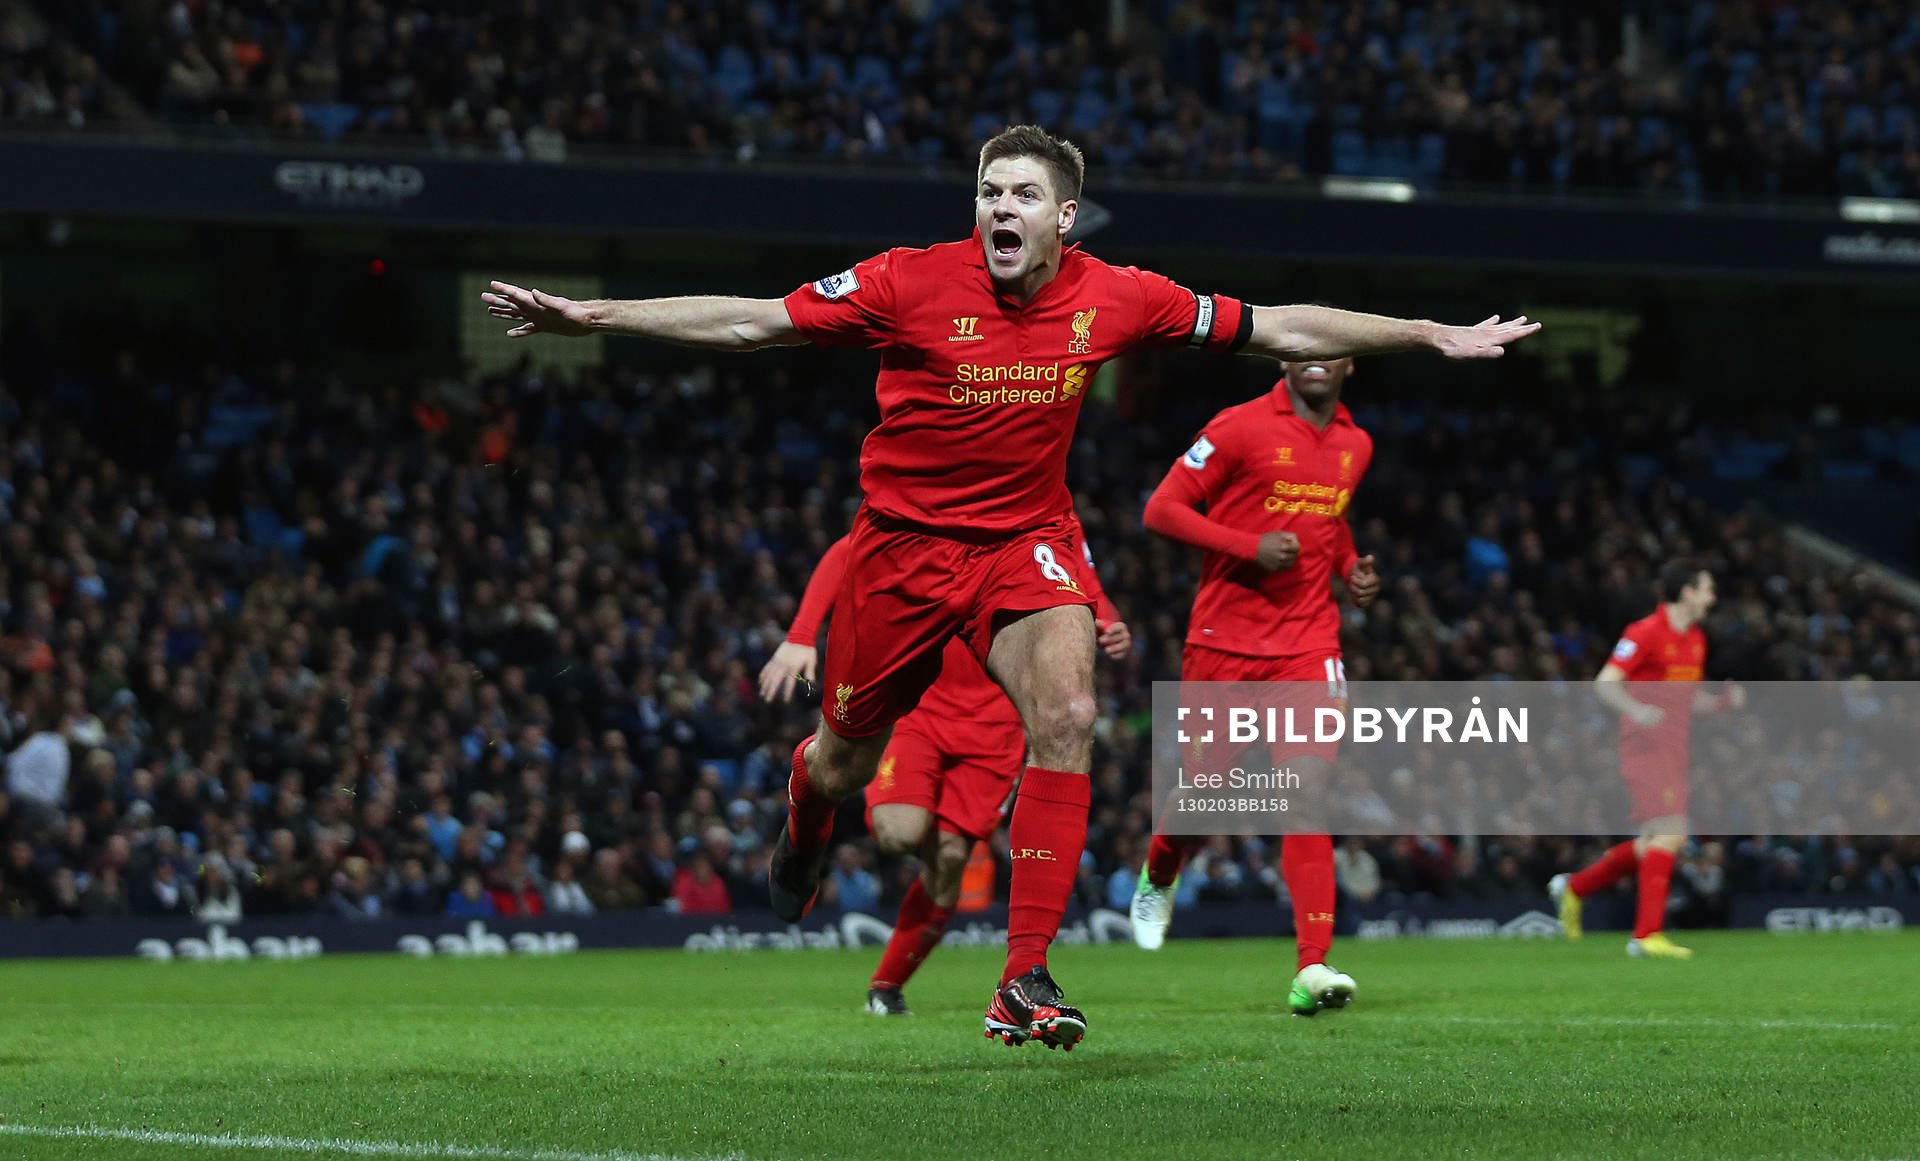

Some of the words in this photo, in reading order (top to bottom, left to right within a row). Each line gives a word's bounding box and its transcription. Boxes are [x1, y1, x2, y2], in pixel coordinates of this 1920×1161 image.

[956, 360, 1059, 382] Standard
[949, 384, 1056, 404] Chartered
[1273, 480, 1337, 499] Standard
[1033, 543, 1072, 583] 8
[1010, 848, 1057, 861] L.F.C.
